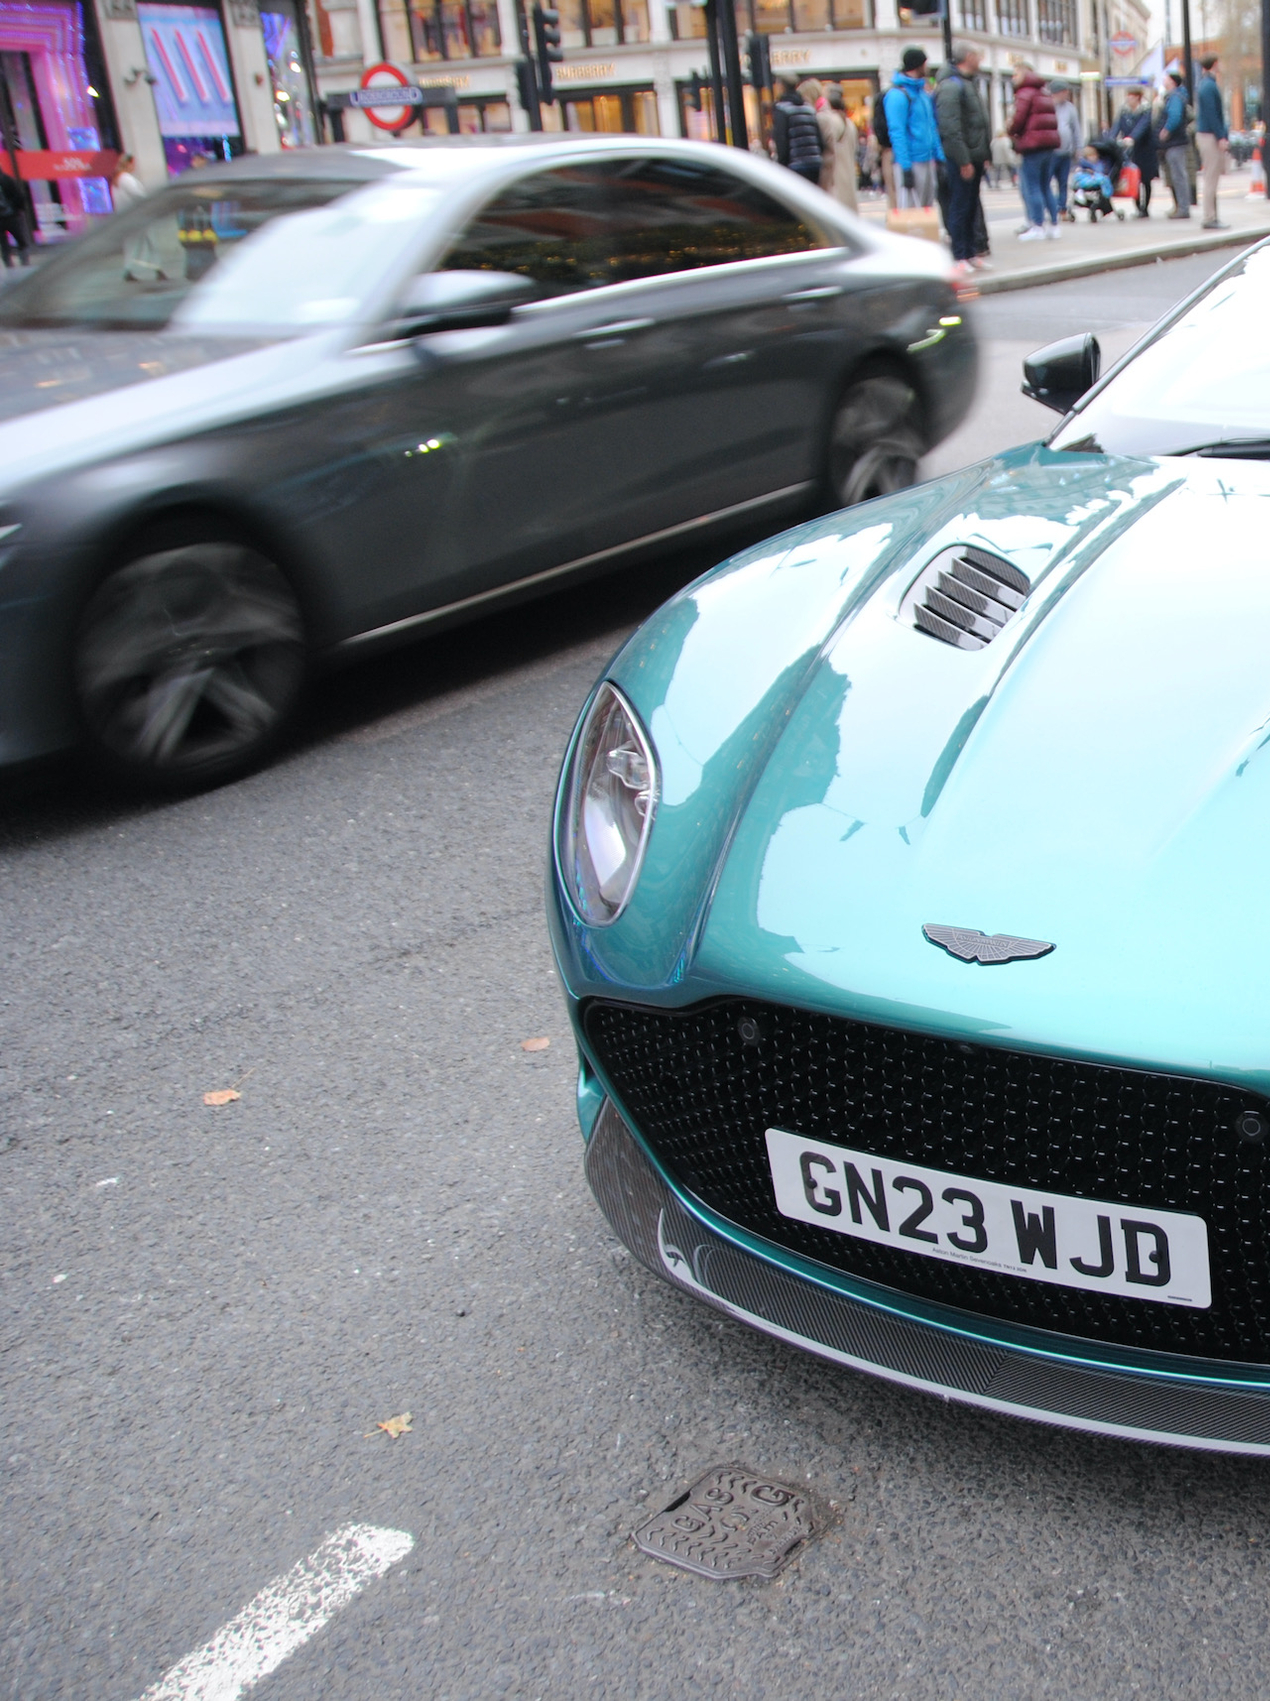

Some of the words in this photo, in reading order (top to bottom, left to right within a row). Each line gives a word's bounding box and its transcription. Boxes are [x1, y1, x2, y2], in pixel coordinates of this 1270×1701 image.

[555, 63, 616, 80] BURBERRY
[349, 86, 421, 107] UNDERGROUND
[799, 1151, 987, 1253] GN23
[1010, 1199, 1171, 1287] WJD
[932, 1247, 949, 1256] Aston
[950, 1251, 968, 1260] Martin
[671, 1487, 735, 1533] GAS
